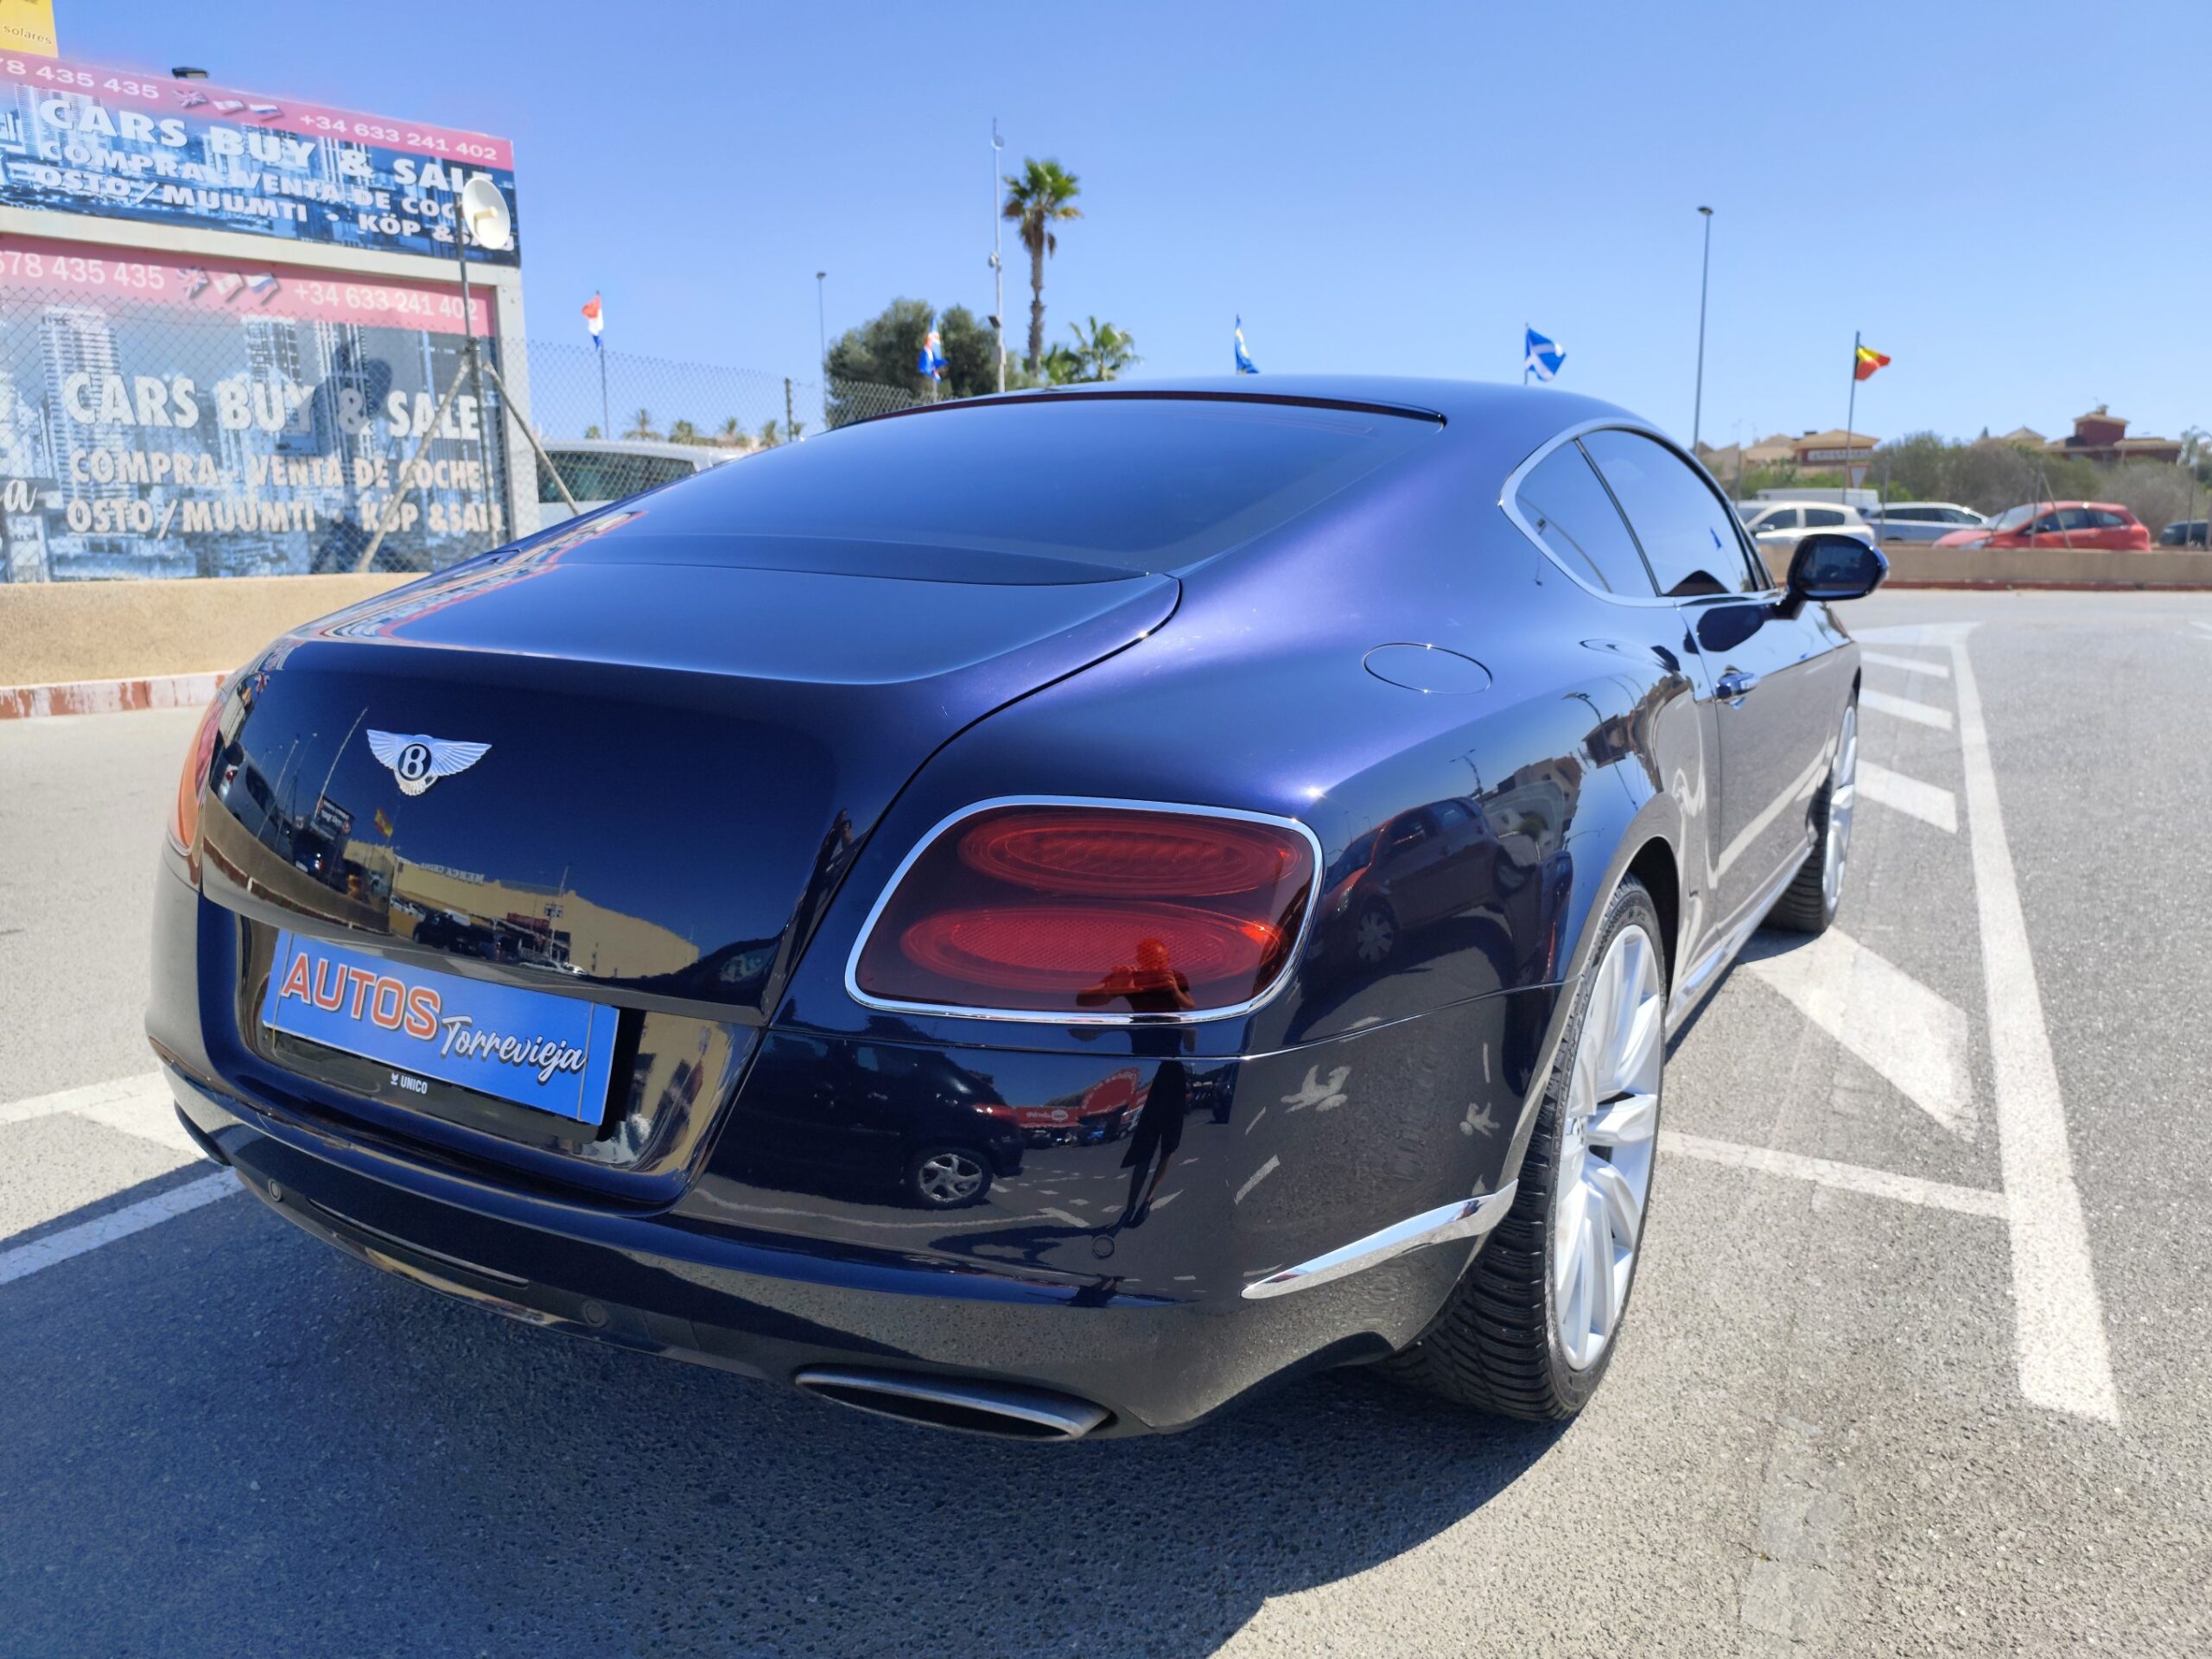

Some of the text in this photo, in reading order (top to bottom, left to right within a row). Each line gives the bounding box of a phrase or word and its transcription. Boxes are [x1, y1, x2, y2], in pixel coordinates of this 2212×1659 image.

[3, 25, 52, 45] solares
[0, 58, 498, 161] 8 435 435 +34 633 241 402
[40, 99, 188, 148] CARS
[210, 126, 316, 169] BUY
[339, 149, 373, 178] &
[42, 141, 208, 182] COMPRA
[232, 169, 343, 204] VENTA
[352, 189, 391, 210] DE
[358, 213, 421, 237] KÖP
[52, 256, 105, 284] 435
[113, 262, 165, 289] 435
[295, 281, 339, 307] +34
[346, 288, 388, 311] 633
[395, 291, 435, 315] 241
[439, 296, 479, 321] 402
[64, 371, 480, 440] CARS BUY & SALE
[69, 448, 221, 485] COMPRA
[249, 454, 344, 487] VENTA
[354, 457, 390, 488] DE
[279, 952, 588, 1085] AUTOS Torrevieja
[400, 1075, 429, 1095] UNICO
